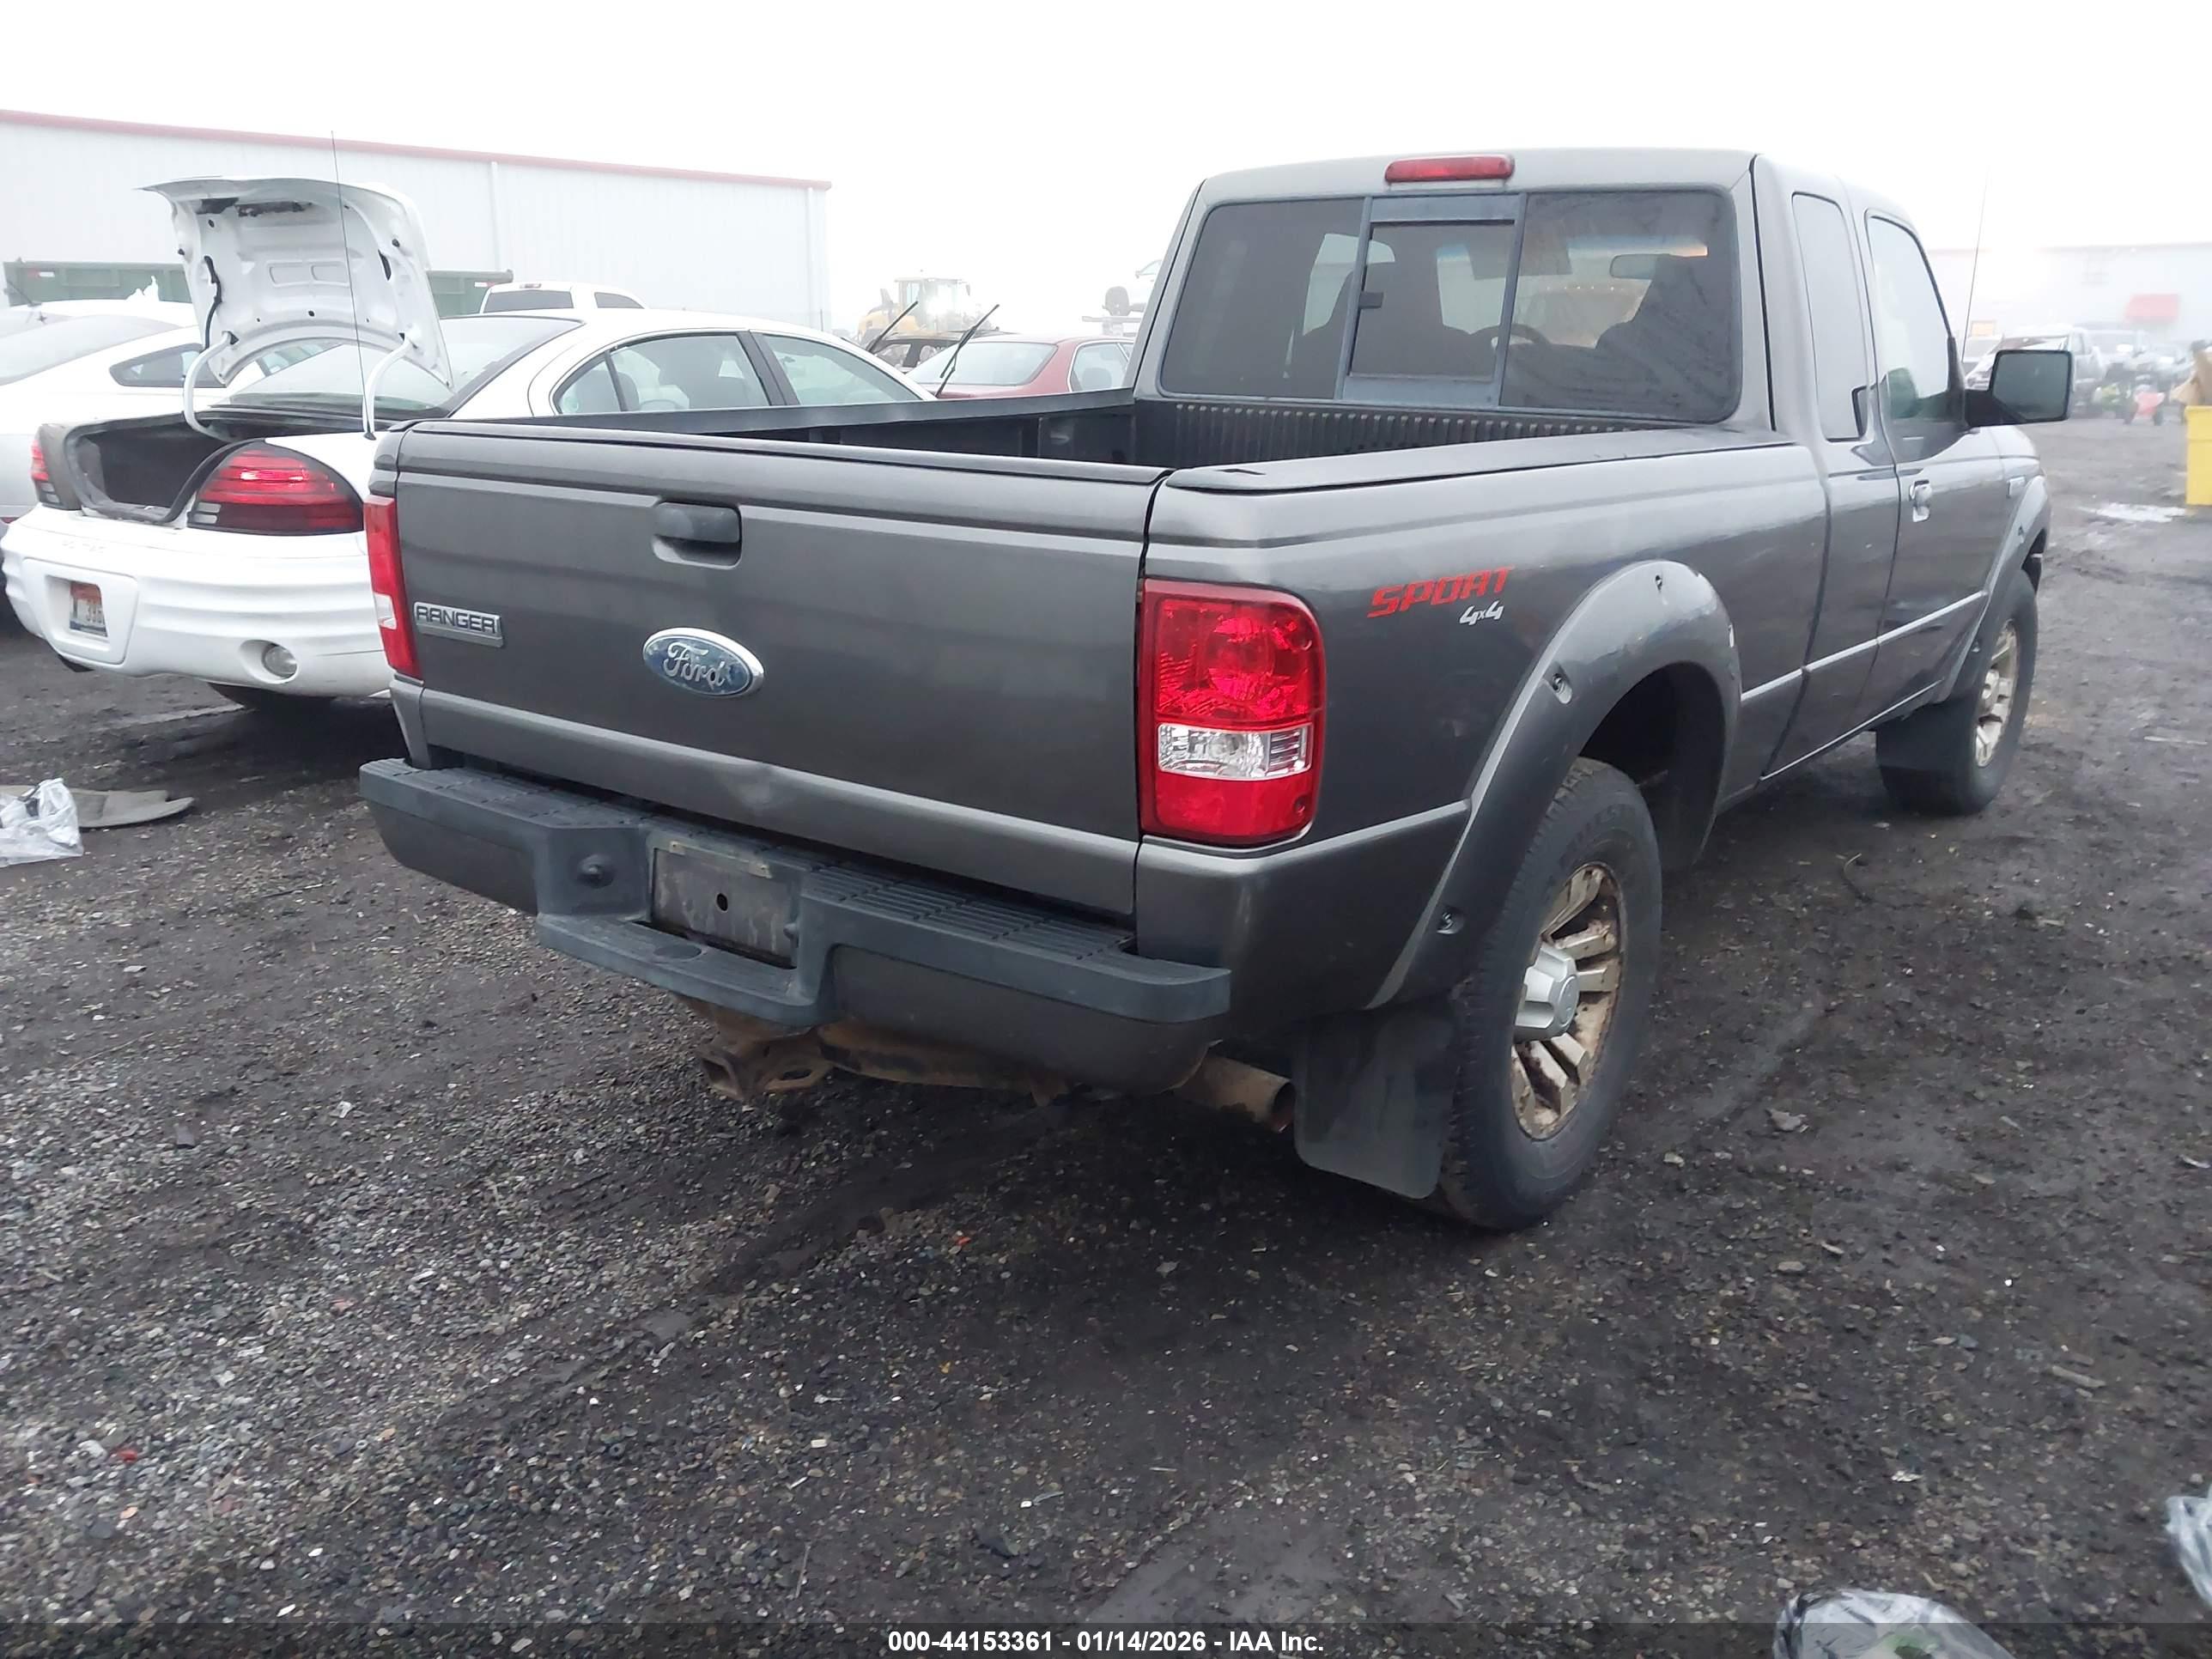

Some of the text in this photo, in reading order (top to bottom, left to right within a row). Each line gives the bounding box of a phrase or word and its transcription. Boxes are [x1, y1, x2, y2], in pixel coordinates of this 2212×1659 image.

[1367, 565, 1516, 618] SPORT
[416, 605, 496, 634] RANGER
[1459, 600, 1504, 626] 4x4
[663, 641, 726, 690] Ford
